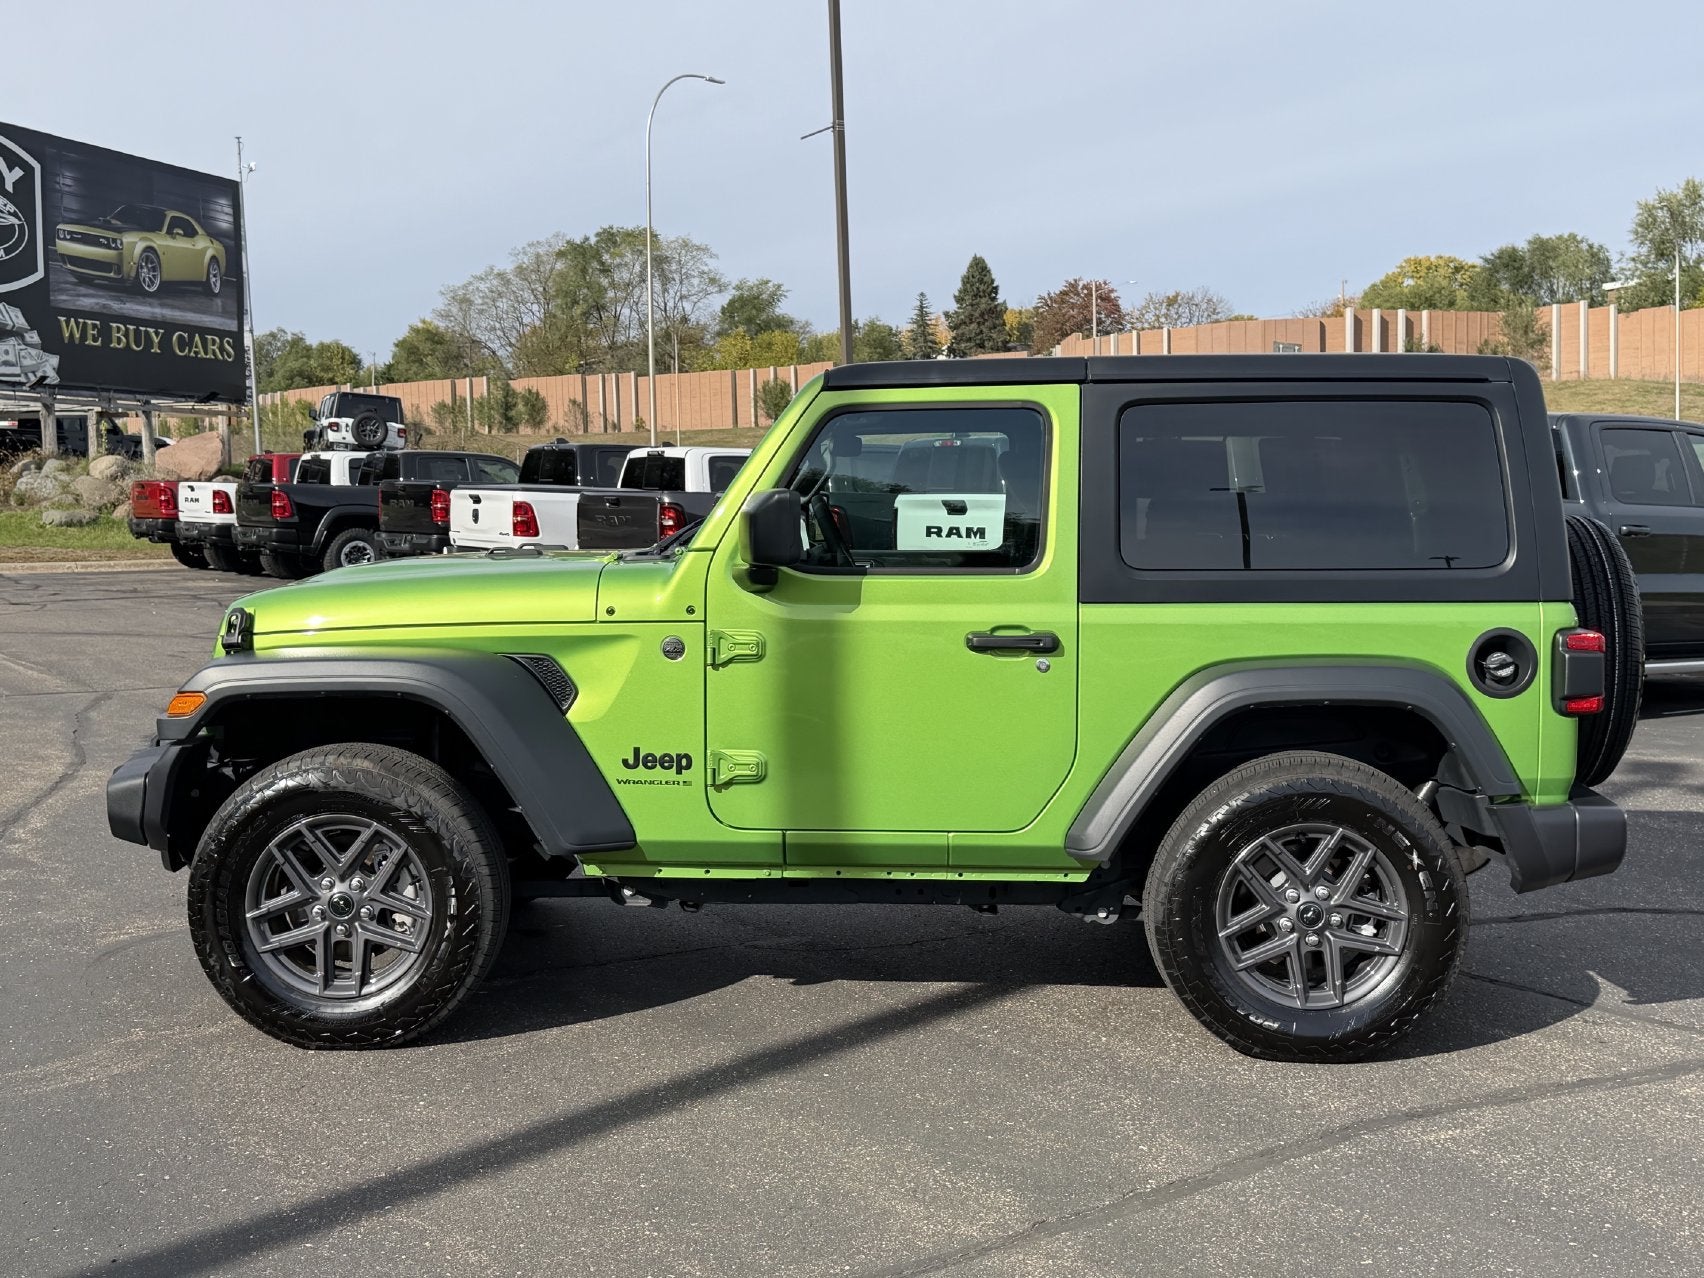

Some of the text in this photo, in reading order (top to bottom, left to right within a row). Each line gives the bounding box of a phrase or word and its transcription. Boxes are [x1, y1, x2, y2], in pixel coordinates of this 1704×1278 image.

[57, 316, 236, 362] WE BUY CARS
[389, 499, 415, 508] RAM
[594, 514, 632, 526] RAM
[925, 525, 986, 540] RAM
[621, 746, 693, 775] Jeep
[615, 778, 680, 786] WRANGLER
